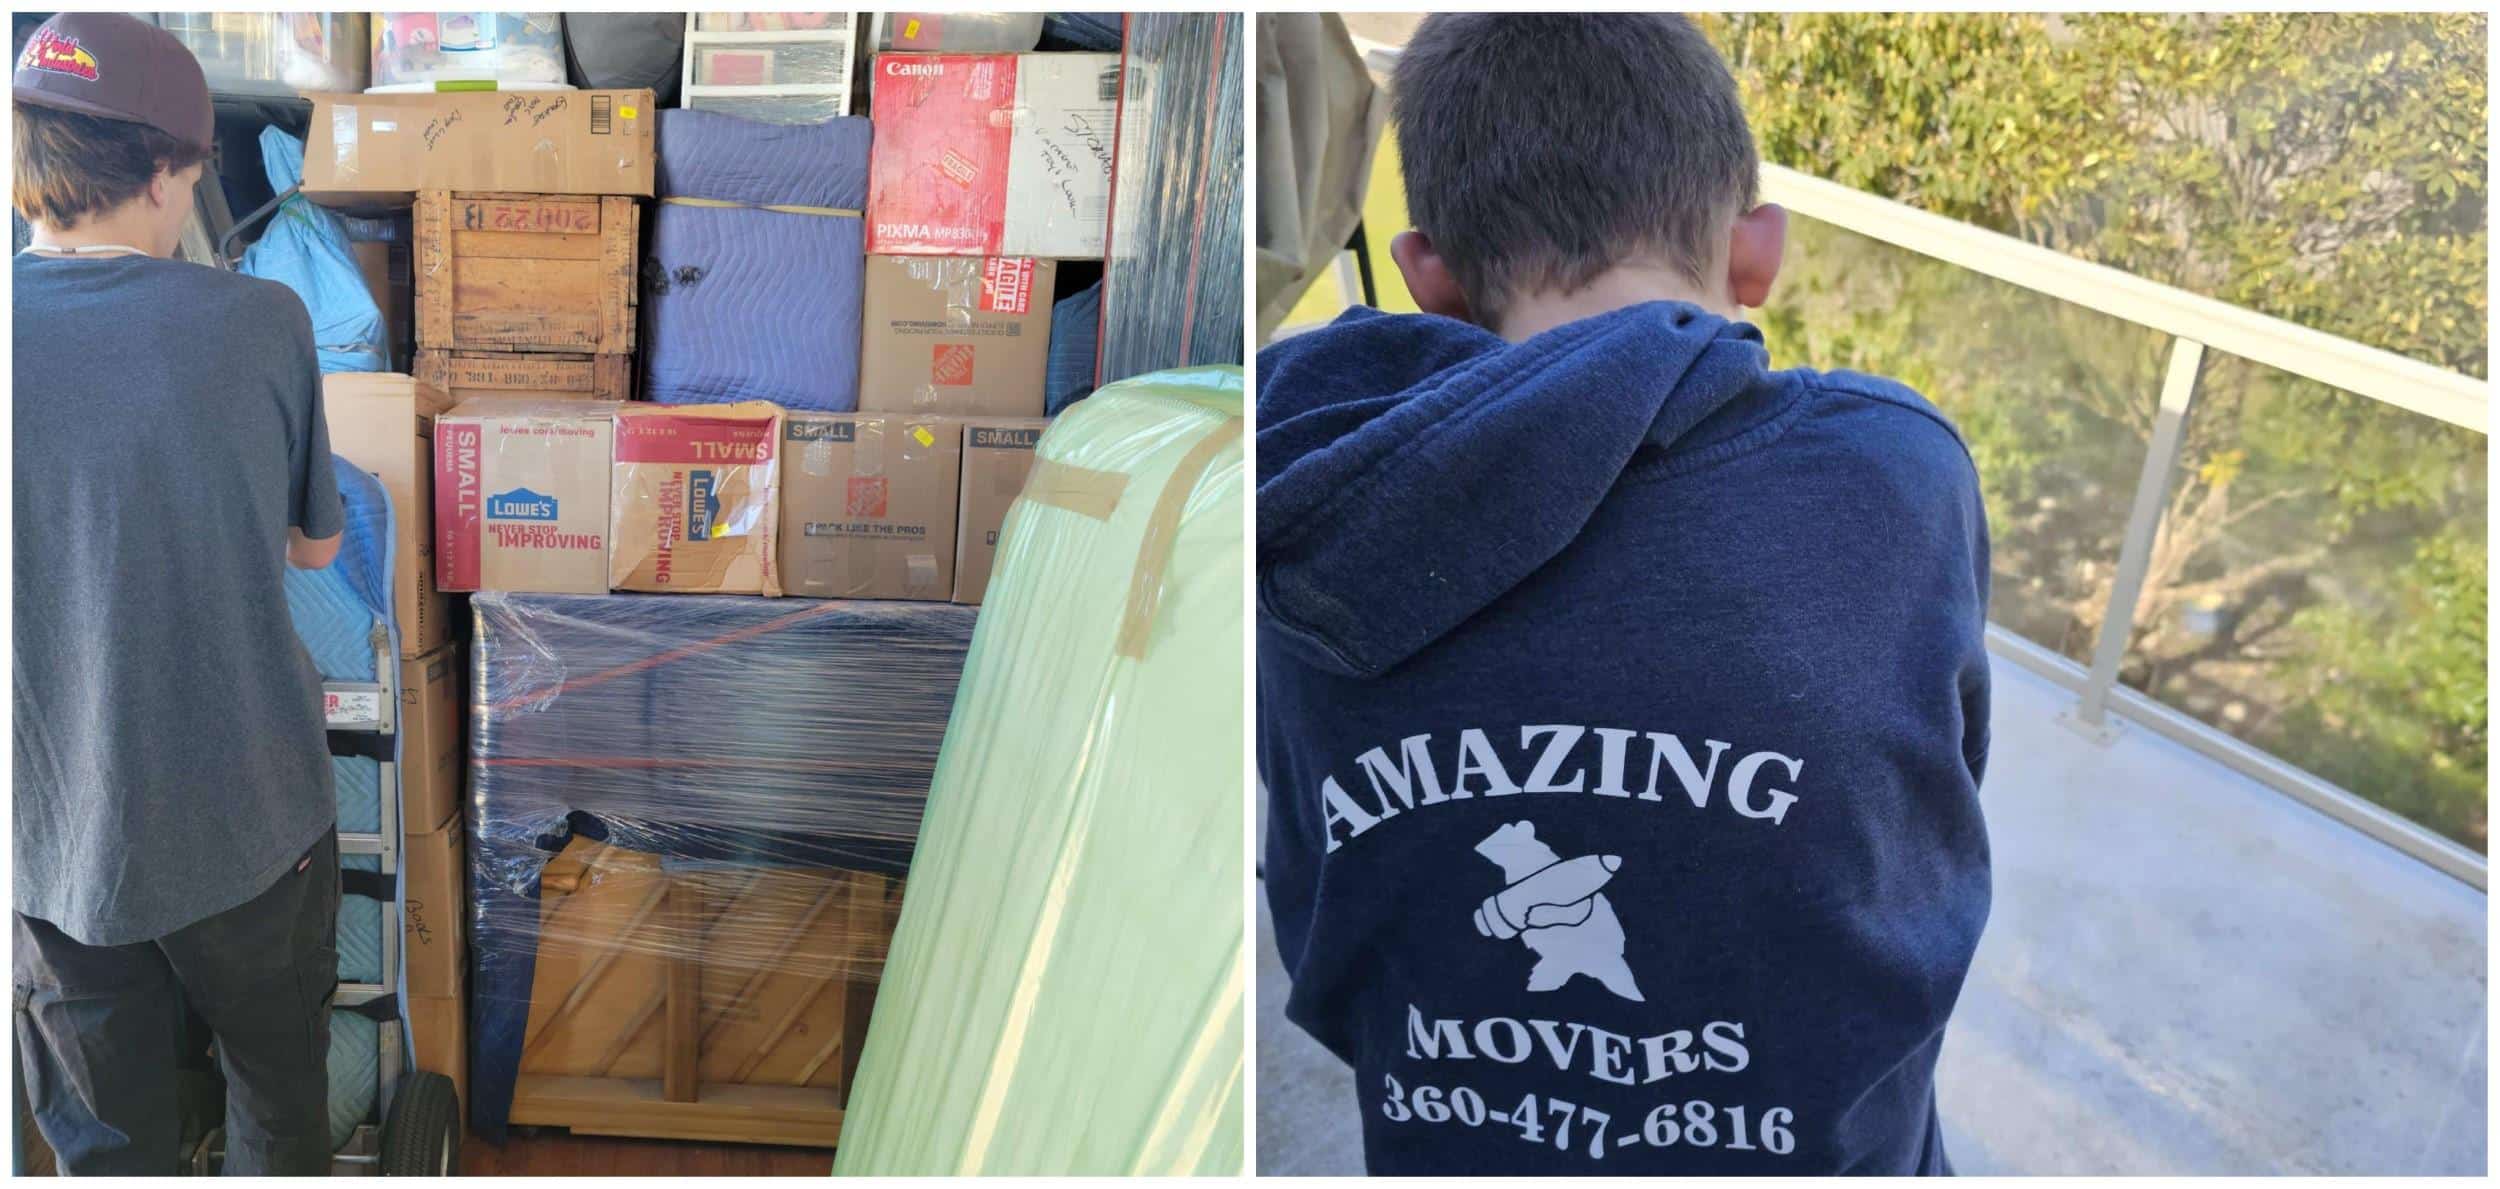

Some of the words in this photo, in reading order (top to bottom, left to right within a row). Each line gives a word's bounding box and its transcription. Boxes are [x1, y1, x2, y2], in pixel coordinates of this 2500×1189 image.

[886, 62, 944, 77] Canon
[877, 224, 931, 239] PIXMA
[997, 257, 1018, 311] AGILE
[792, 424, 849, 438] SMALL
[976, 430, 1034, 446] SMALL
[690, 441, 769, 460] SMALL
[458, 431, 476, 518] SMALL
[673, 471, 683, 510] NEVER
[494, 500, 552, 518] LOWE'S
[692, 478, 709, 534] LOWES
[488, 524, 526, 535] NEVER
[529, 525, 558, 535] STOP
[656, 481, 673, 584] IMPROVING
[673, 512, 682, 541] STOP
[874, 525, 895, 534] THE
[896, 525, 927, 535] PROS
[497, 533, 602, 550] IMPROVING
[1321, 724, 1804, 853] AMAZING
[1406, 1003, 1750, 1085] MOVERS
[1382, 1073, 1796, 1159] 360-477-6816
